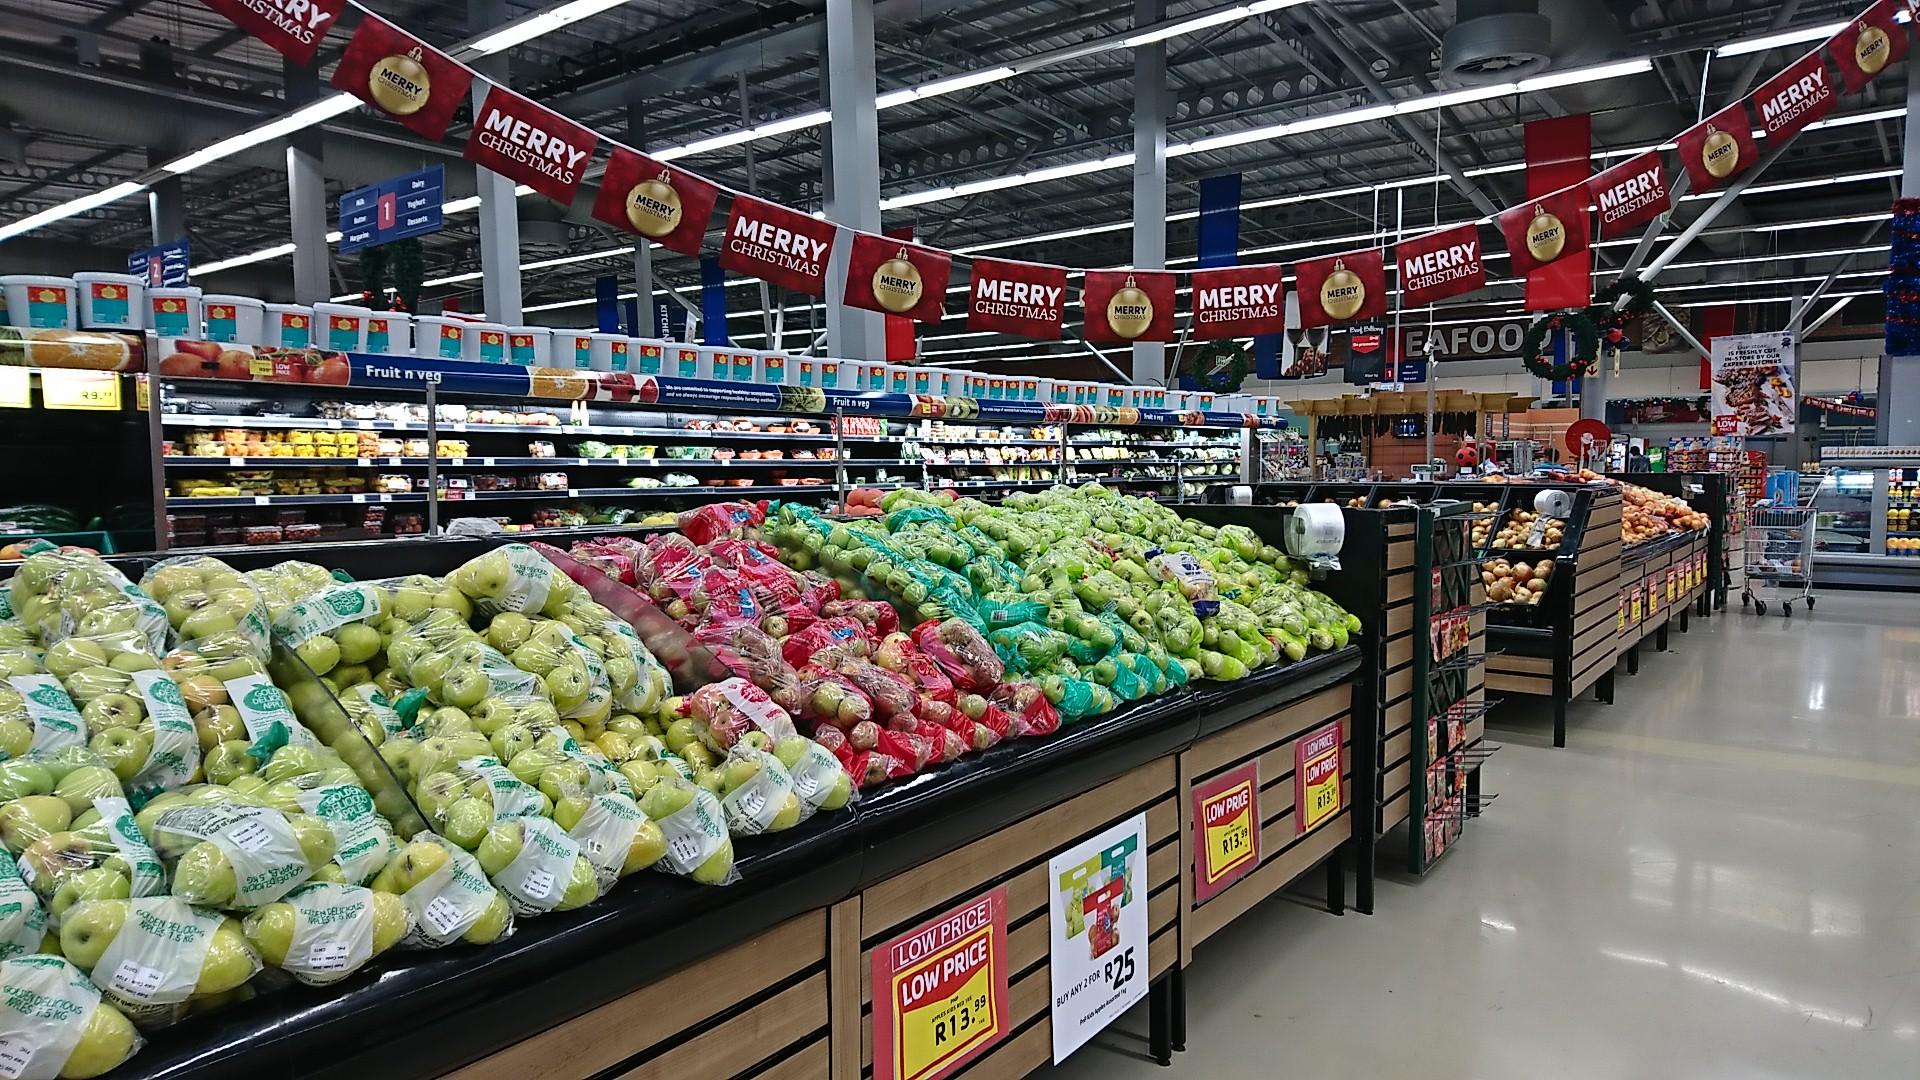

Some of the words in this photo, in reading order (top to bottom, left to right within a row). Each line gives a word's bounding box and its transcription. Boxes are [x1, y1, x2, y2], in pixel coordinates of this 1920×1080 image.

[1860, 36, 1884, 59] MERRY
[381, 67, 422, 96] MERRY
[1762, 66, 1824, 122] MERRY
[1768, 85, 1830, 133] CHRISTMAS
[484, 109, 586, 170] MERRY
[478, 131, 574, 185] CHRISTMAS
[1708, 142, 1732, 161] MERRY
[1599, 166, 1661, 212] MERRY
[383, 201, 390, 221] 1
[633, 203, 671, 223] CHRISTMAS
[635, 194, 675, 215] MERRY
[1604, 186, 1665, 223] CHRISTMAS
[734, 216, 828, 261] MERRY
[1532, 226, 1559, 244] MERRY
[730, 239, 821, 278] CHRISTMAS
[1405, 241, 1477, 279] MERRY
[153, 263, 159, 278] 2
[1407, 262, 1480, 292] CHRISTMAS
[879, 284, 914, 296] CHRISTMAS
[880, 275, 916, 291] MERRY
[976, 278, 1062, 307] MERRY
[1327, 286, 1358, 299] MERRY
[1199, 283, 1279, 309] MERRY
[975, 300, 1057, 321] CHRISTMAS
[1114, 305, 1147, 315] MERRY
[1199, 304, 1278, 324] CHRISTMAS
[1748, 358, 1783, 366] BUTCHERS
[365, 364, 401, 379] Fruit
[404, 369, 414, 379] n
[416, 369, 442, 385] veg
[833, 397, 850, 406] Fruit
[851, 399, 857, 407] n
[857, 399, 870, 409] veg
[1717, 420, 1737, 428] LOW
[1307, 742, 1319, 756] LOW
[1318, 733, 1333, 749] PRICE
[1307, 762, 1320, 783] LOW
[1320, 753, 1337, 775] PRICE
[1206, 801, 1225, 824] LOW
[1226, 789, 1249, 813] PRICE
[135, 909, 166, 929] GOLDEN
[345, 911, 357, 920] KG
[138, 920, 164, 937] APPLES
[168, 931, 182, 942] 1.5
[182, 934, 194, 943] KG
[899, 928, 937, 966] LOW
[941, 903, 987, 945] PRICE
[902, 962, 940, 1007] LOW
[943, 937, 987, 983] PRICE
[1056, 990, 1070, 1008] BUY
[1070, 981, 1083, 998] ANY
[1083, 978, 1088, 989] 2
[1088, 969, 1101, 985] FOR
[1104, 946, 1135, 991] R25
[34, 995, 83, 1015] DELICIOUS
[35, 1007, 51, 1018] 1.5
[53, 1010, 68, 1021] KG
[120, 998, 141, 1012] South
[931, 1010, 946, 1023] APPLES
[946, 1004, 956, 1014] KIDS
[1087, 1011, 1095, 1020] Kids
[1094, 1003, 1106, 1015] Apples
[1105, 991, 1121, 1006] Assorted
[935, 994, 986, 1046] R13.99
